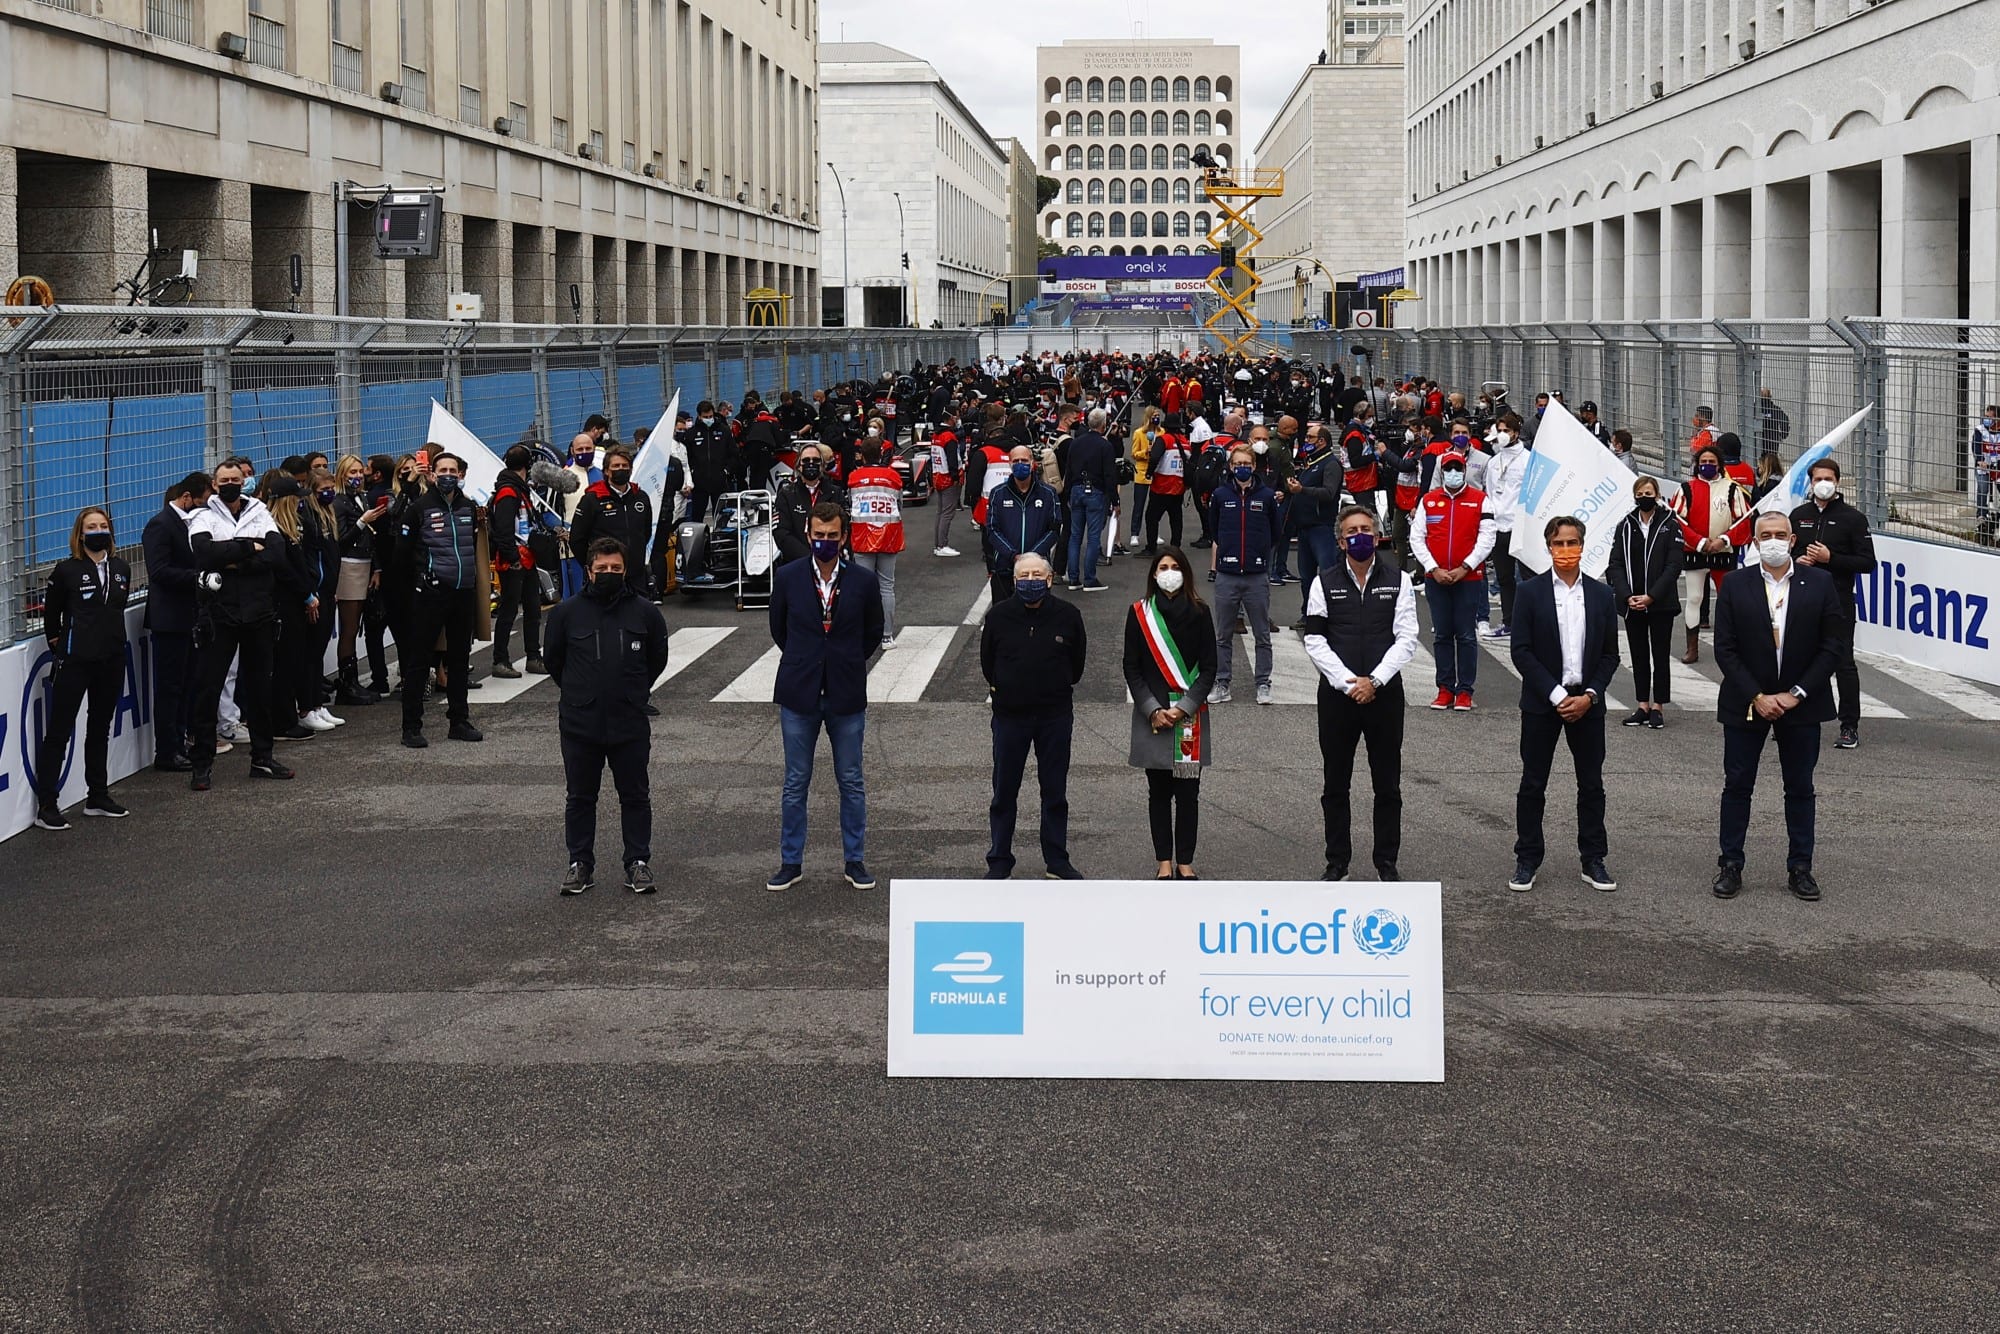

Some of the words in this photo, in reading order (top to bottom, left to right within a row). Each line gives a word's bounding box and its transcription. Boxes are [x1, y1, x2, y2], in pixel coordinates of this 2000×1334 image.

[1125, 261, 1155, 273] enel
[1065, 283, 1096, 291] BOSCH
[1175, 282, 1206, 290] BOSCH
[871, 501, 892, 514] 926
[1199, 908, 1347, 955] unicef
[1055, 970, 1071, 985] in
[1075, 972, 1144, 989] support
[1149, 970, 1167, 986] of
[930, 992, 996, 1005] FORMULA
[998, 992, 1007, 1005] E
[1200, 987, 1241, 1017] for
[1248, 995, 1335, 1025] every
[1343, 989, 1411, 1018] child
[1219, 1032, 1264, 1043] DONATE
[1267, 1033, 1298, 1043] NOW:
[1301, 1033, 1393, 1046] donate.unicef.org
